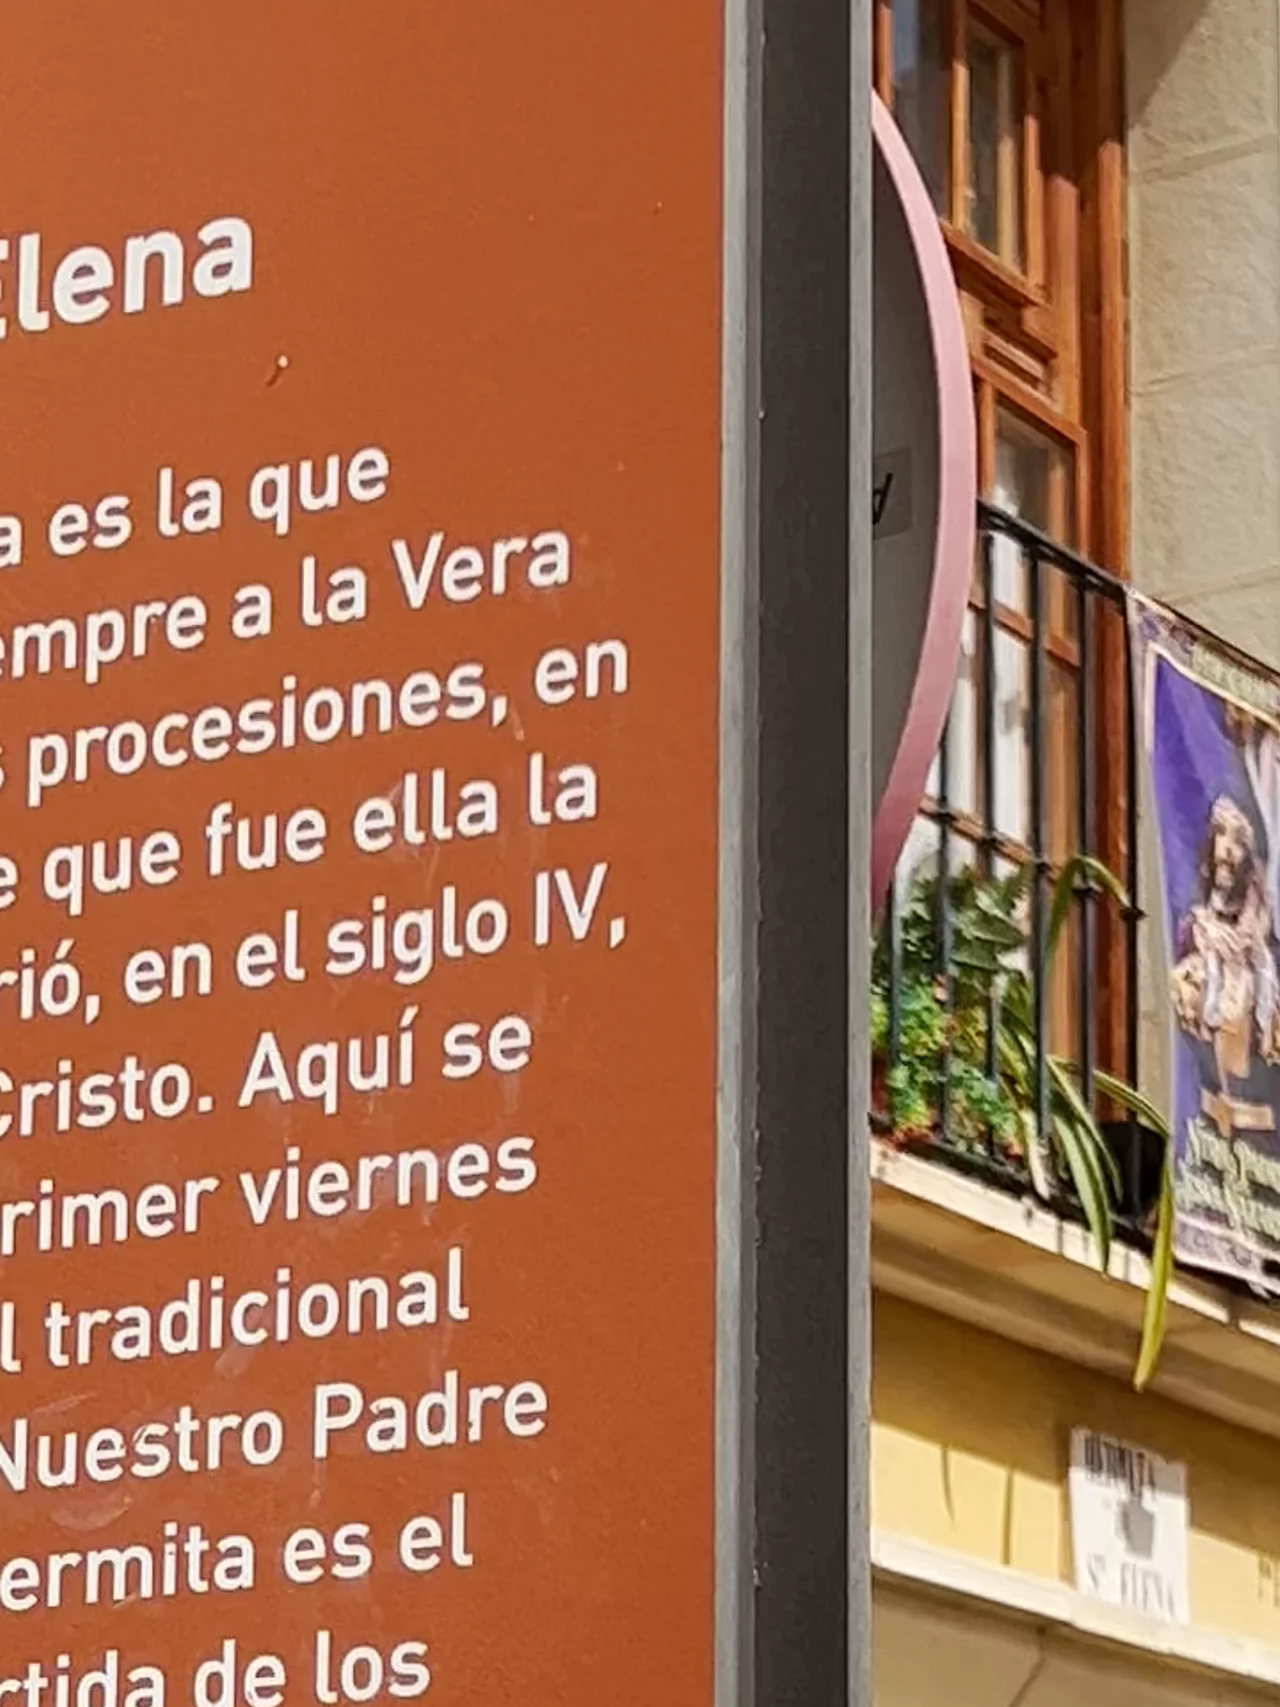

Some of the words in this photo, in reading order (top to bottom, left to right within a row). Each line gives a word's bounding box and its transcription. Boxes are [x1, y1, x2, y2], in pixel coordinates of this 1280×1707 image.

[48, 495, 132, 557] es
[157, 466, 223, 538] la
[248, 446, 390, 536] que
[231, 583, 272, 639] a
[301, 555, 367, 627] la
[391, 530, 570, 610] Vera
[27, 663, 508, 808] procesiones,
[534, 638, 628, 705] en
[42, 830, 181, 917] que
[204, 801, 327, 877] fue
[352, 767, 499, 853] ella
[528, 751, 597, 826] la
[123, 942, 213, 1004] en
[235, 908, 306, 988] el
[324, 885, 509, 986] siglo
[534, 862, 626, 949] IV,
[237, 1005, 421, 1116] Aquí
[441, 1015, 533, 1079] se
[238, 1135, 538, 1225] viernes
[43, 1246, 470, 1368] tradicional
[313, 1369, 548, 1459] Padre
[282, 1522, 373, 1584] es
[398, 1491, 474, 1572] el
[314, 1629, 432, 1705] los
